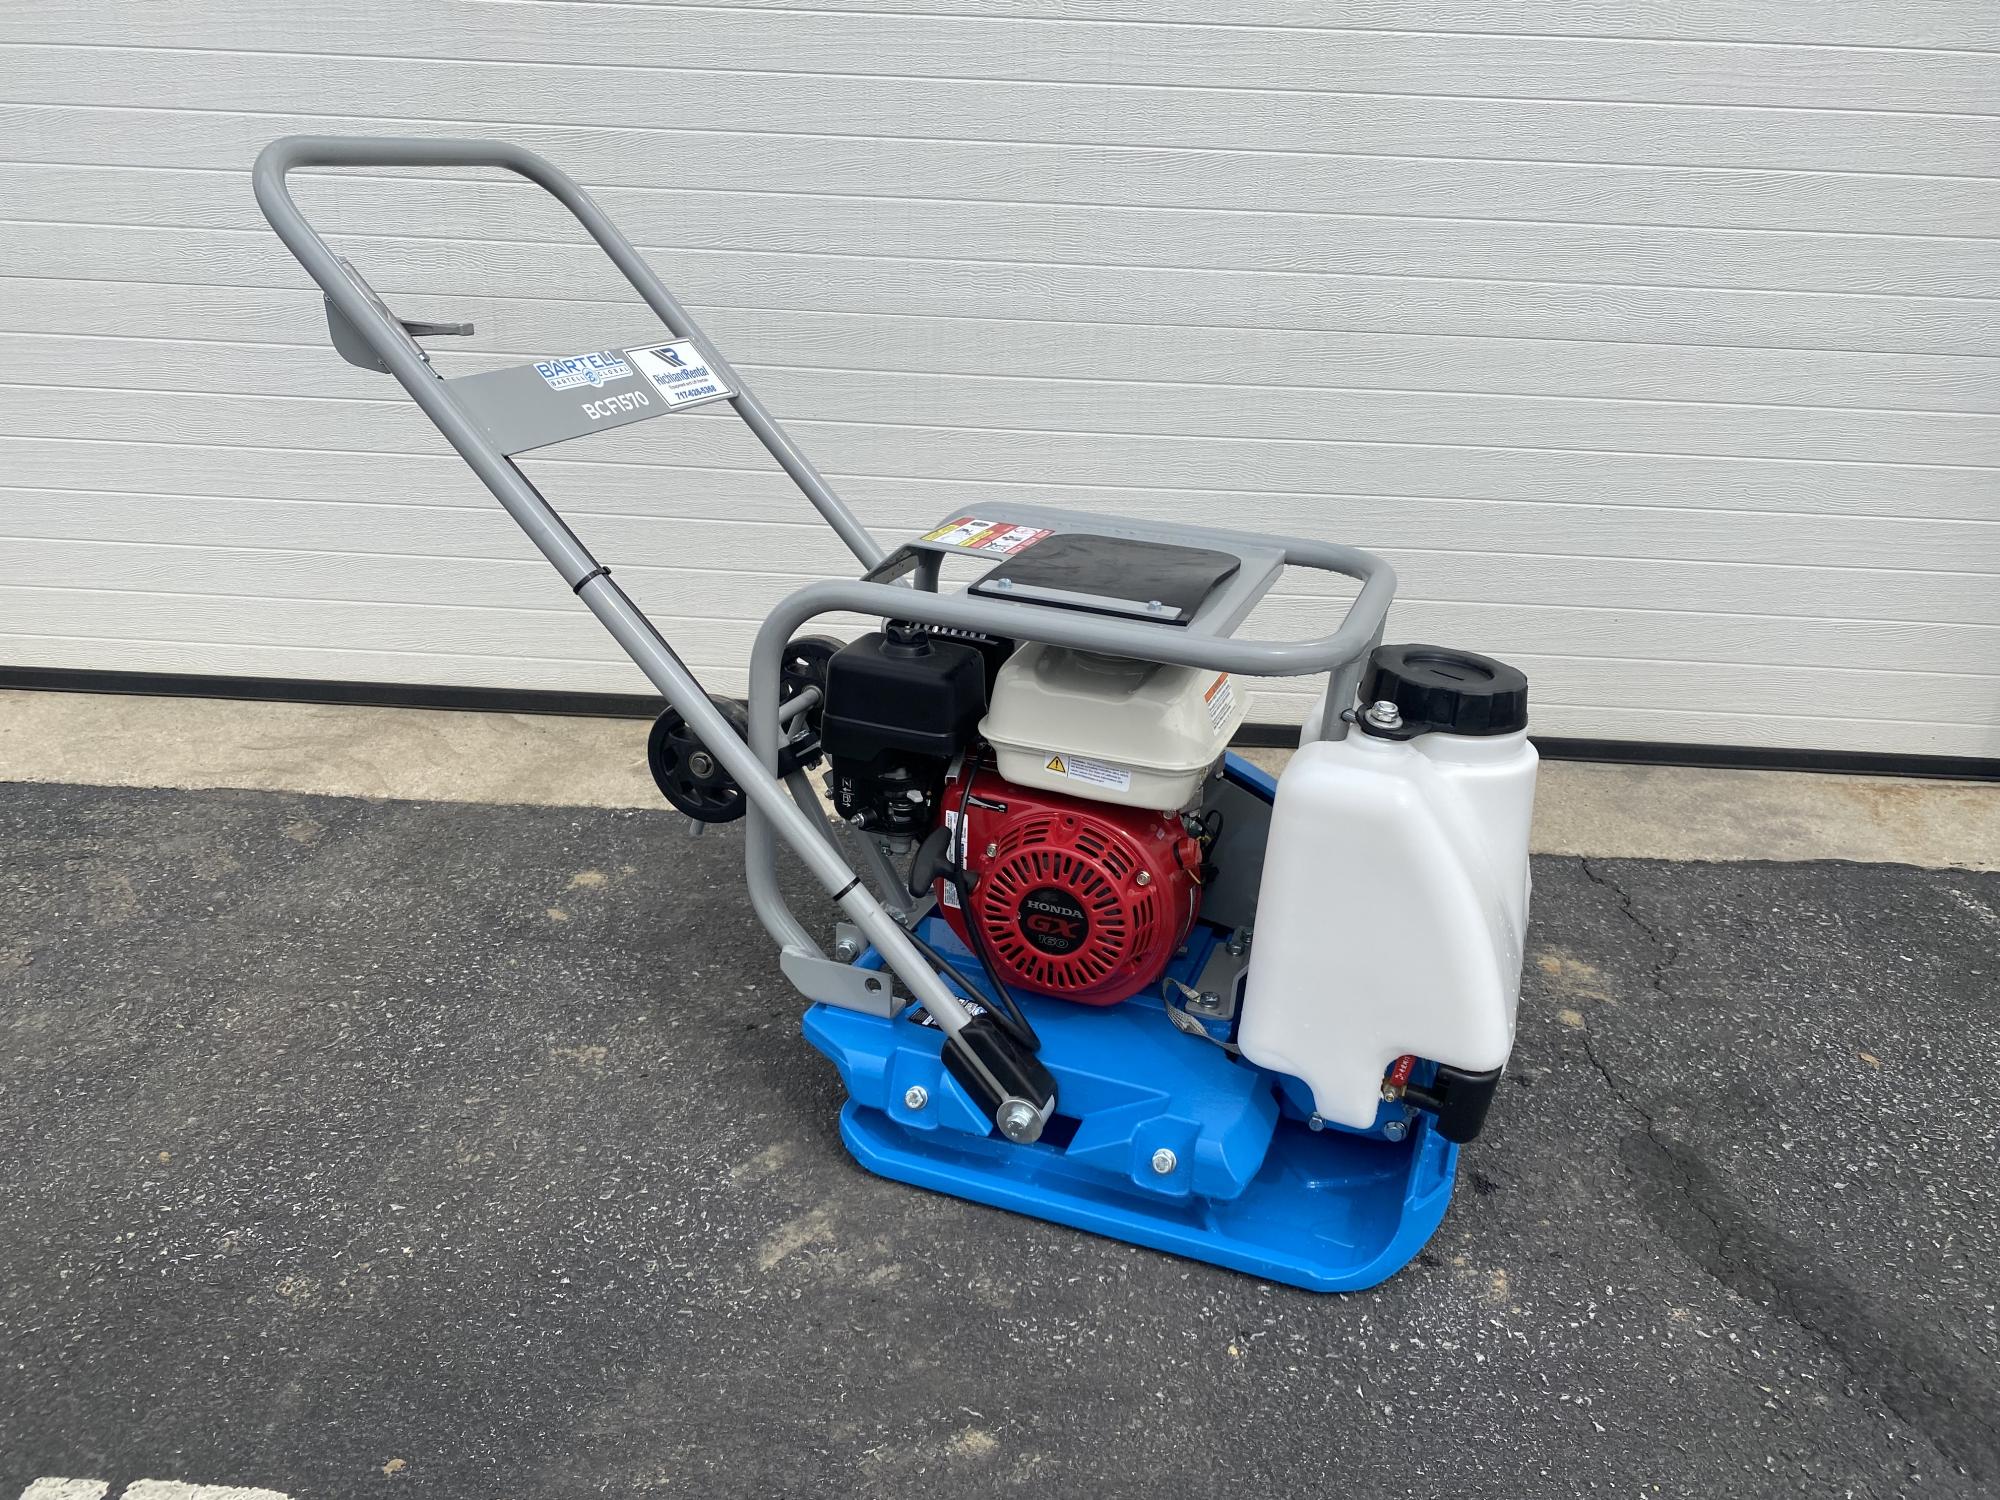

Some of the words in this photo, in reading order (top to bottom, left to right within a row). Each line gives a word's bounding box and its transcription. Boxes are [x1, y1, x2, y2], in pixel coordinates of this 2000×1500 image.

[536, 352, 624, 379] BARTELL
[550, 375, 585, 387] BARTELL
[597, 367, 629, 377] GLOBAL
[1027, 900, 1084, 919] HONDA
[1027, 914, 1081, 938] GX
[1038, 934, 1069, 948] 160
